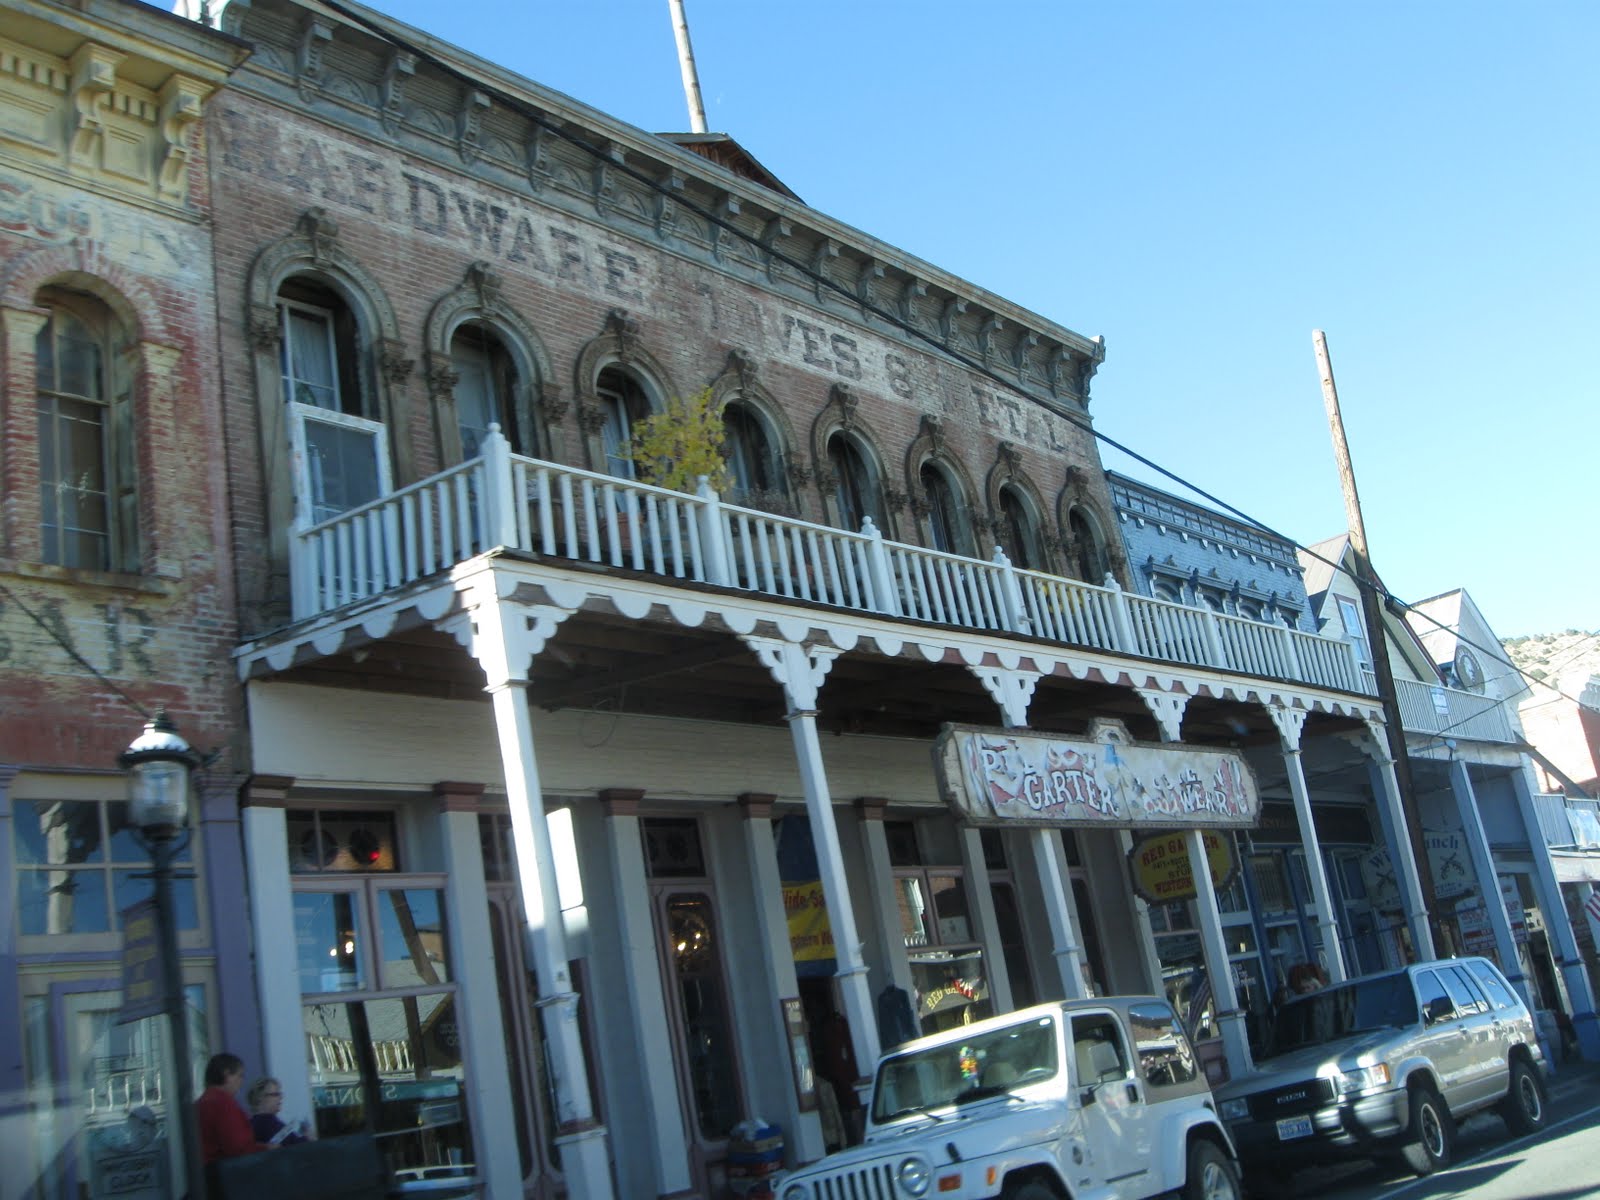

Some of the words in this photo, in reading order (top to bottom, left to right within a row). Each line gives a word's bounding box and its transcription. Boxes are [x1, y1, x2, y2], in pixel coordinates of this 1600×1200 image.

[222, 108, 644, 303] HARDWARE
[1024, 769, 1120, 818] GARTER
[1142, 844, 1165, 866] RED
[1167, 835, 1220, 854] GAER
